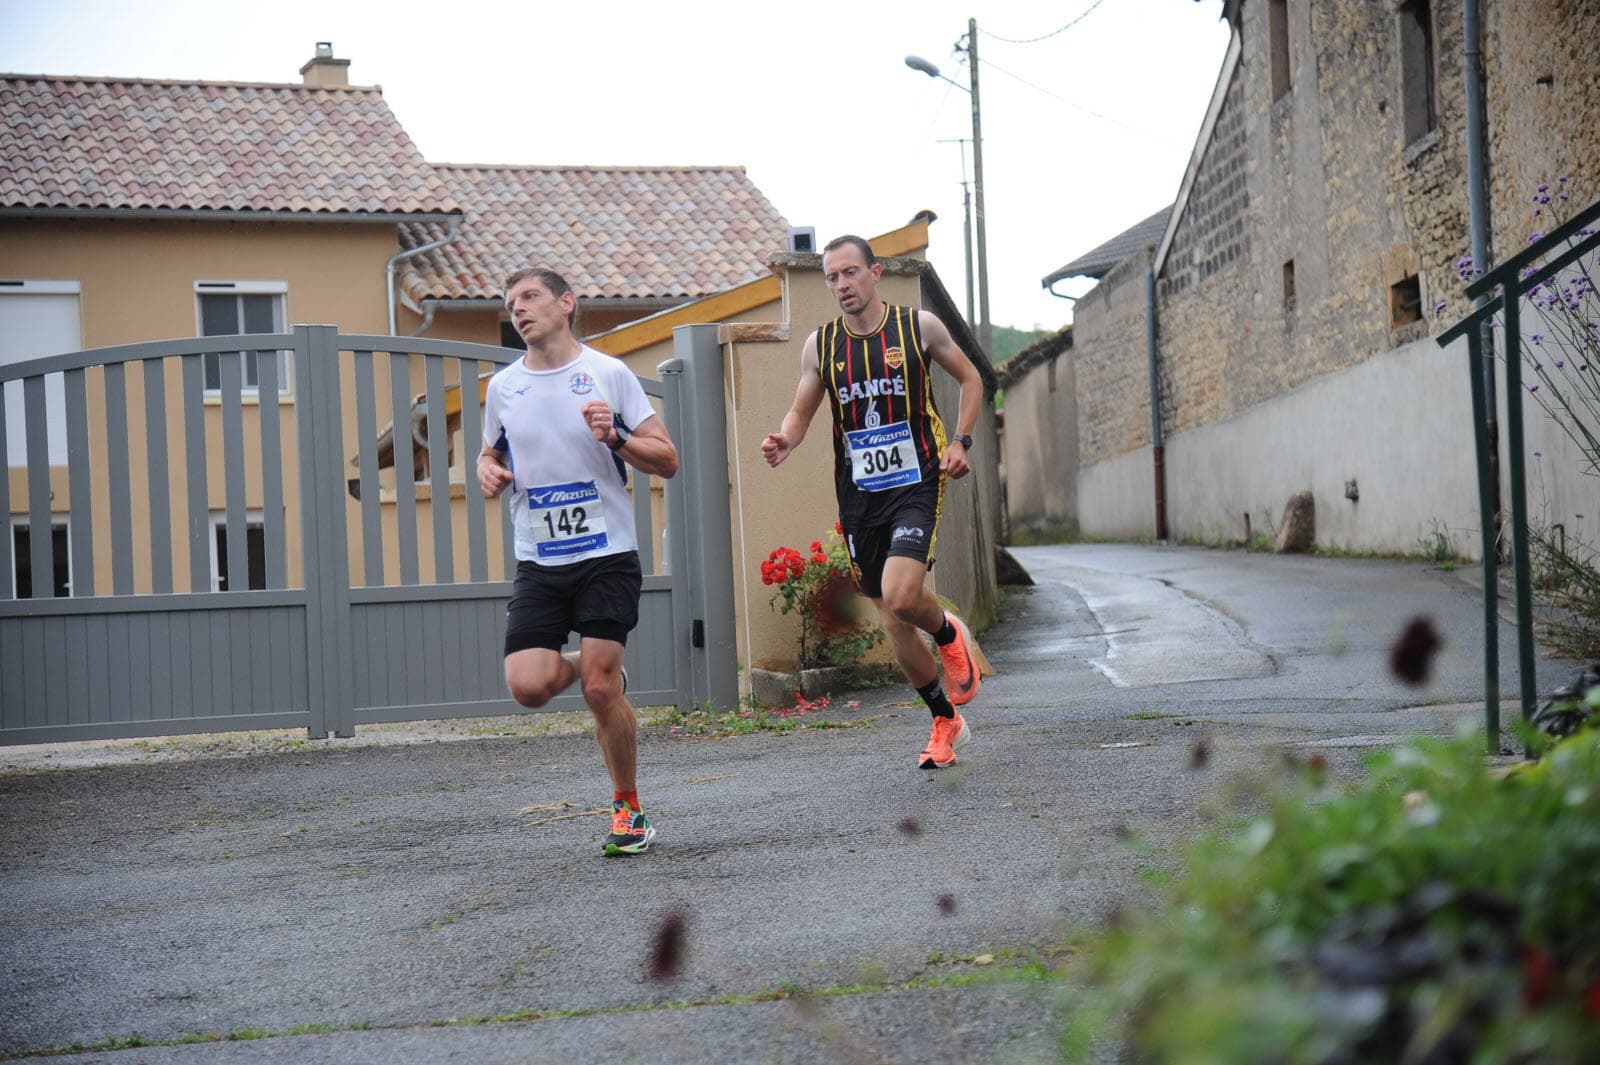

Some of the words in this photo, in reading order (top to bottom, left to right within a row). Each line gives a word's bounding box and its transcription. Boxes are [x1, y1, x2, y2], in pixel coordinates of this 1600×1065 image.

[839, 375, 906, 405] SANCÉ
[865, 400, 881, 429] 6
[863, 446, 903, 475] 304
[543, 506, 590, 538] 142
